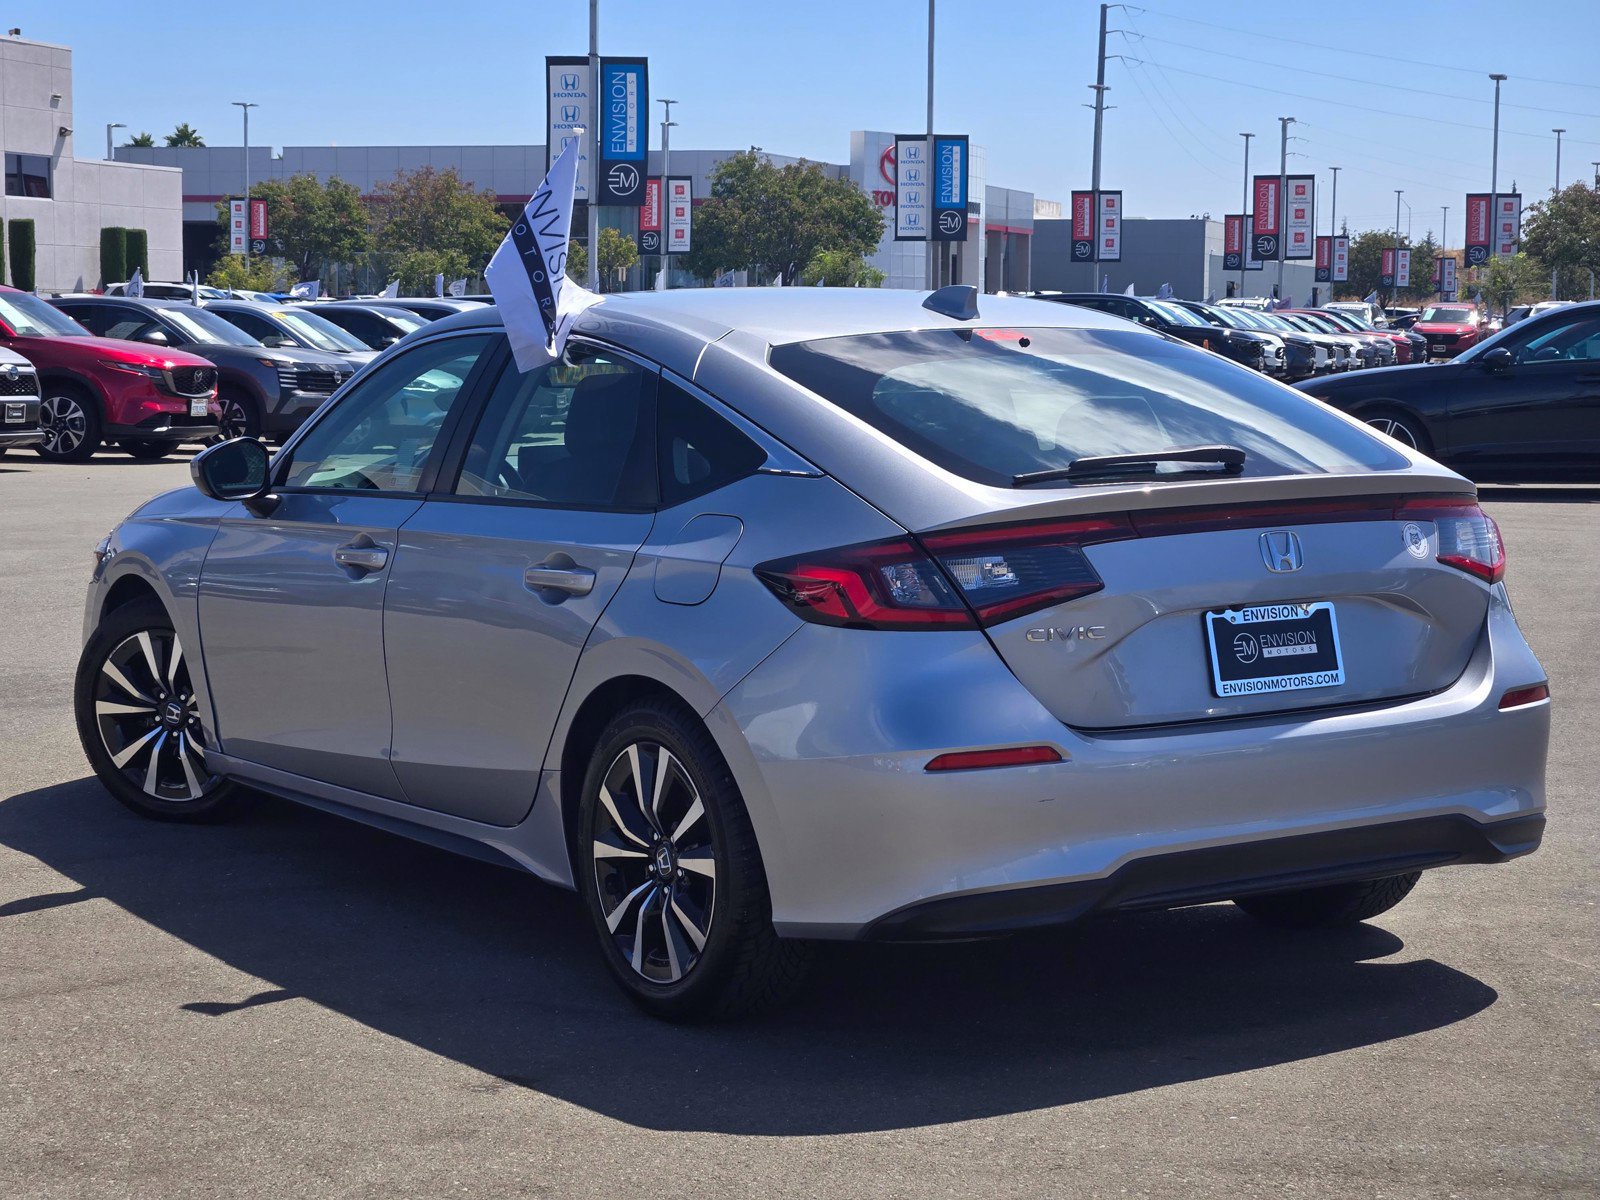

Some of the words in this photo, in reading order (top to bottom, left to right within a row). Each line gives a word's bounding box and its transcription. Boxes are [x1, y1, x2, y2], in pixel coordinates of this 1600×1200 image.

[611, 71, 626, 153] ENVISION
[941, 145, 953, 203] ENVISION
[1259, 183, 1268, 230] ENVISION
[1242, 605, 1299, 622] ENVISION
[1025, 625, 1106, 642] CIVIC
[1259, 631, 1317, 648] ENVISION
[1267, 645, 1313, 655] MOTORS
[1222, 673, 1340, 694] ENVISIONMOTORS.COM
